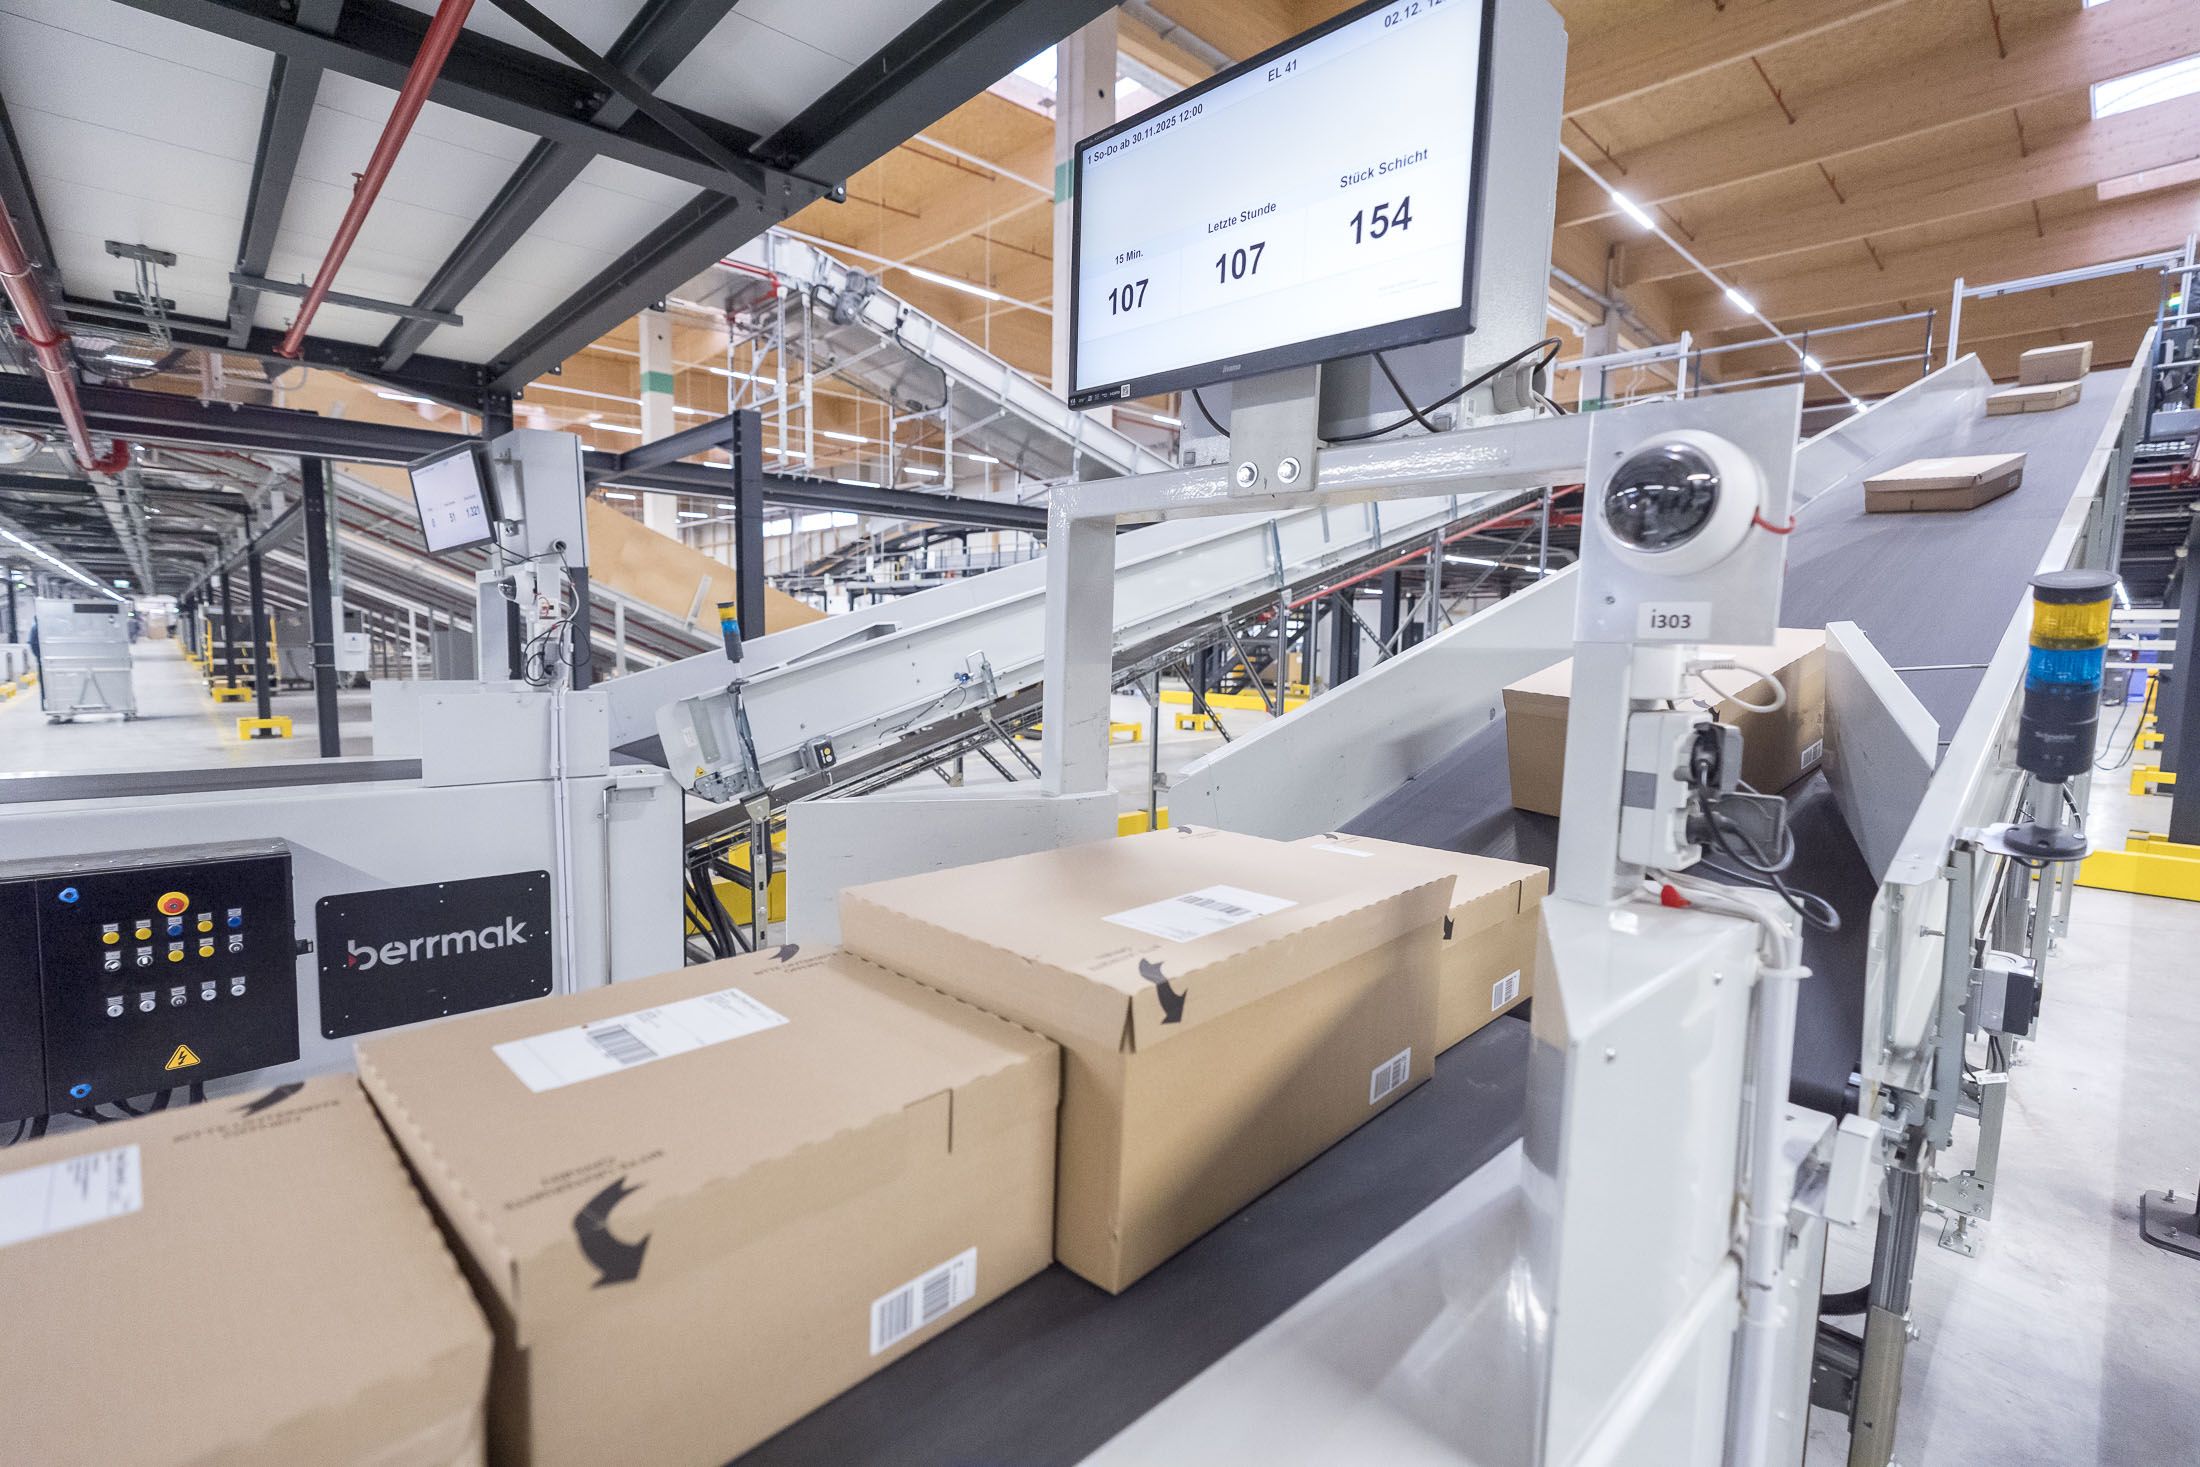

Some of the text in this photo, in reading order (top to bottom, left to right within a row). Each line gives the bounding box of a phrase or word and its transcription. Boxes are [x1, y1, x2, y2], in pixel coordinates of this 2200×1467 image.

[1384, 2, 1422, 28] 02.12.
[1268, 59, 1297, 82] EL 41
[1088, 155, 1092, 164] 1
[1094, 145, 1118, 162] So-Do
[1120, 138, 1130, 150] ab
[1132, 115, 1176, 145] 30.11.2025
[1180, 103, 1203, 123] 12:00
[1340, 148, 1428, 188] Stück Schicht
[1208, 202, 1277, 234] Letzte Stunde
[1350, 195, 1413, 244] 154
[1115, 249, 1144, 265] 15 Min.
[1215, 241, 1266, 284] 107
[1108, 278, 1149, 316] 107
[1651, 608, 1692, 629] i303
[347, 916, 528, 971] berrmak
